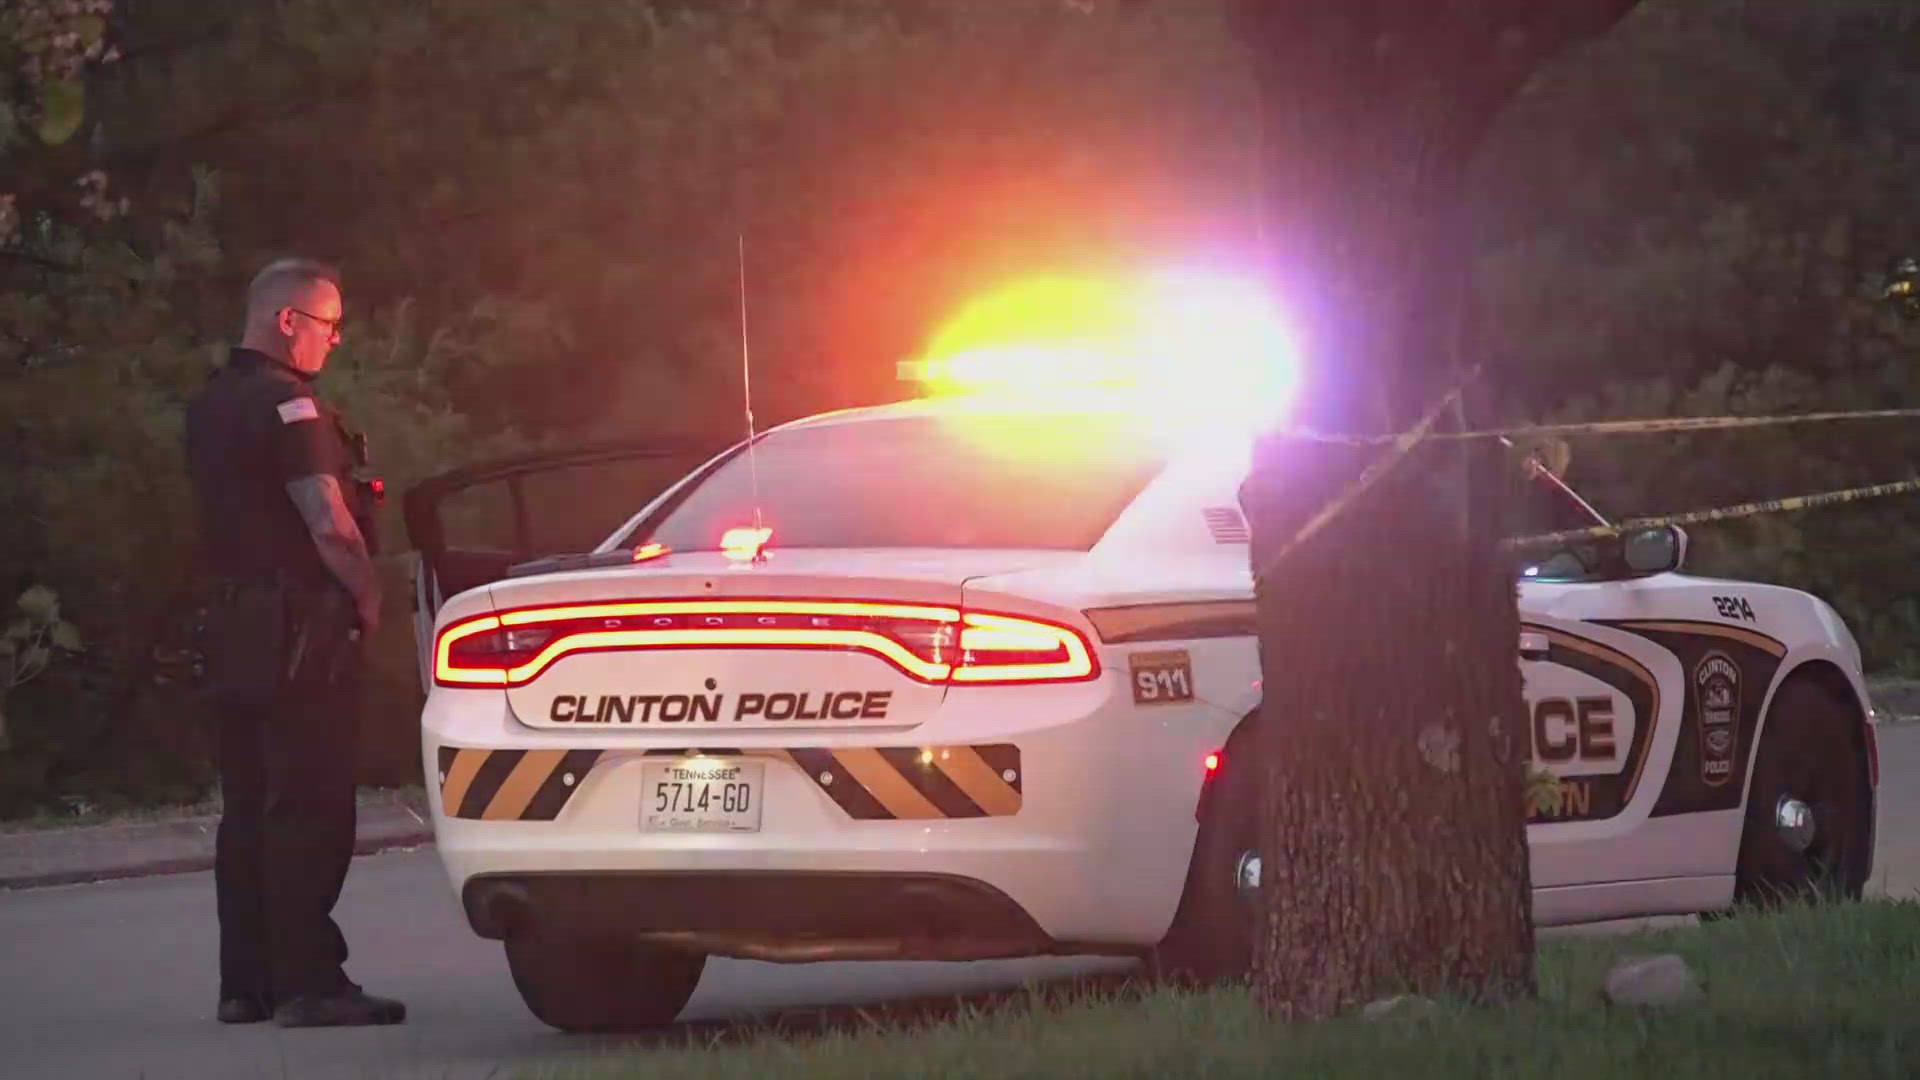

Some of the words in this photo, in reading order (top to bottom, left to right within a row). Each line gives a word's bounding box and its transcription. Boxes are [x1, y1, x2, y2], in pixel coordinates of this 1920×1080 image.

[604, 615, 832, 628] DODGE
[1712, 596, 1756, 623] 2214
[1137, 669, 1189, 698] 911
[1699, 659, 1737, 685] CLINTON
[550, 694, 724, 723] CLINTON
[734, 690, 892, 721] POLICE
[672, 768, 736, 780] TENNESSEE
[1704, 760, 1730, 774] POLICE
[656, 782, 750, 812] 5714-GD
